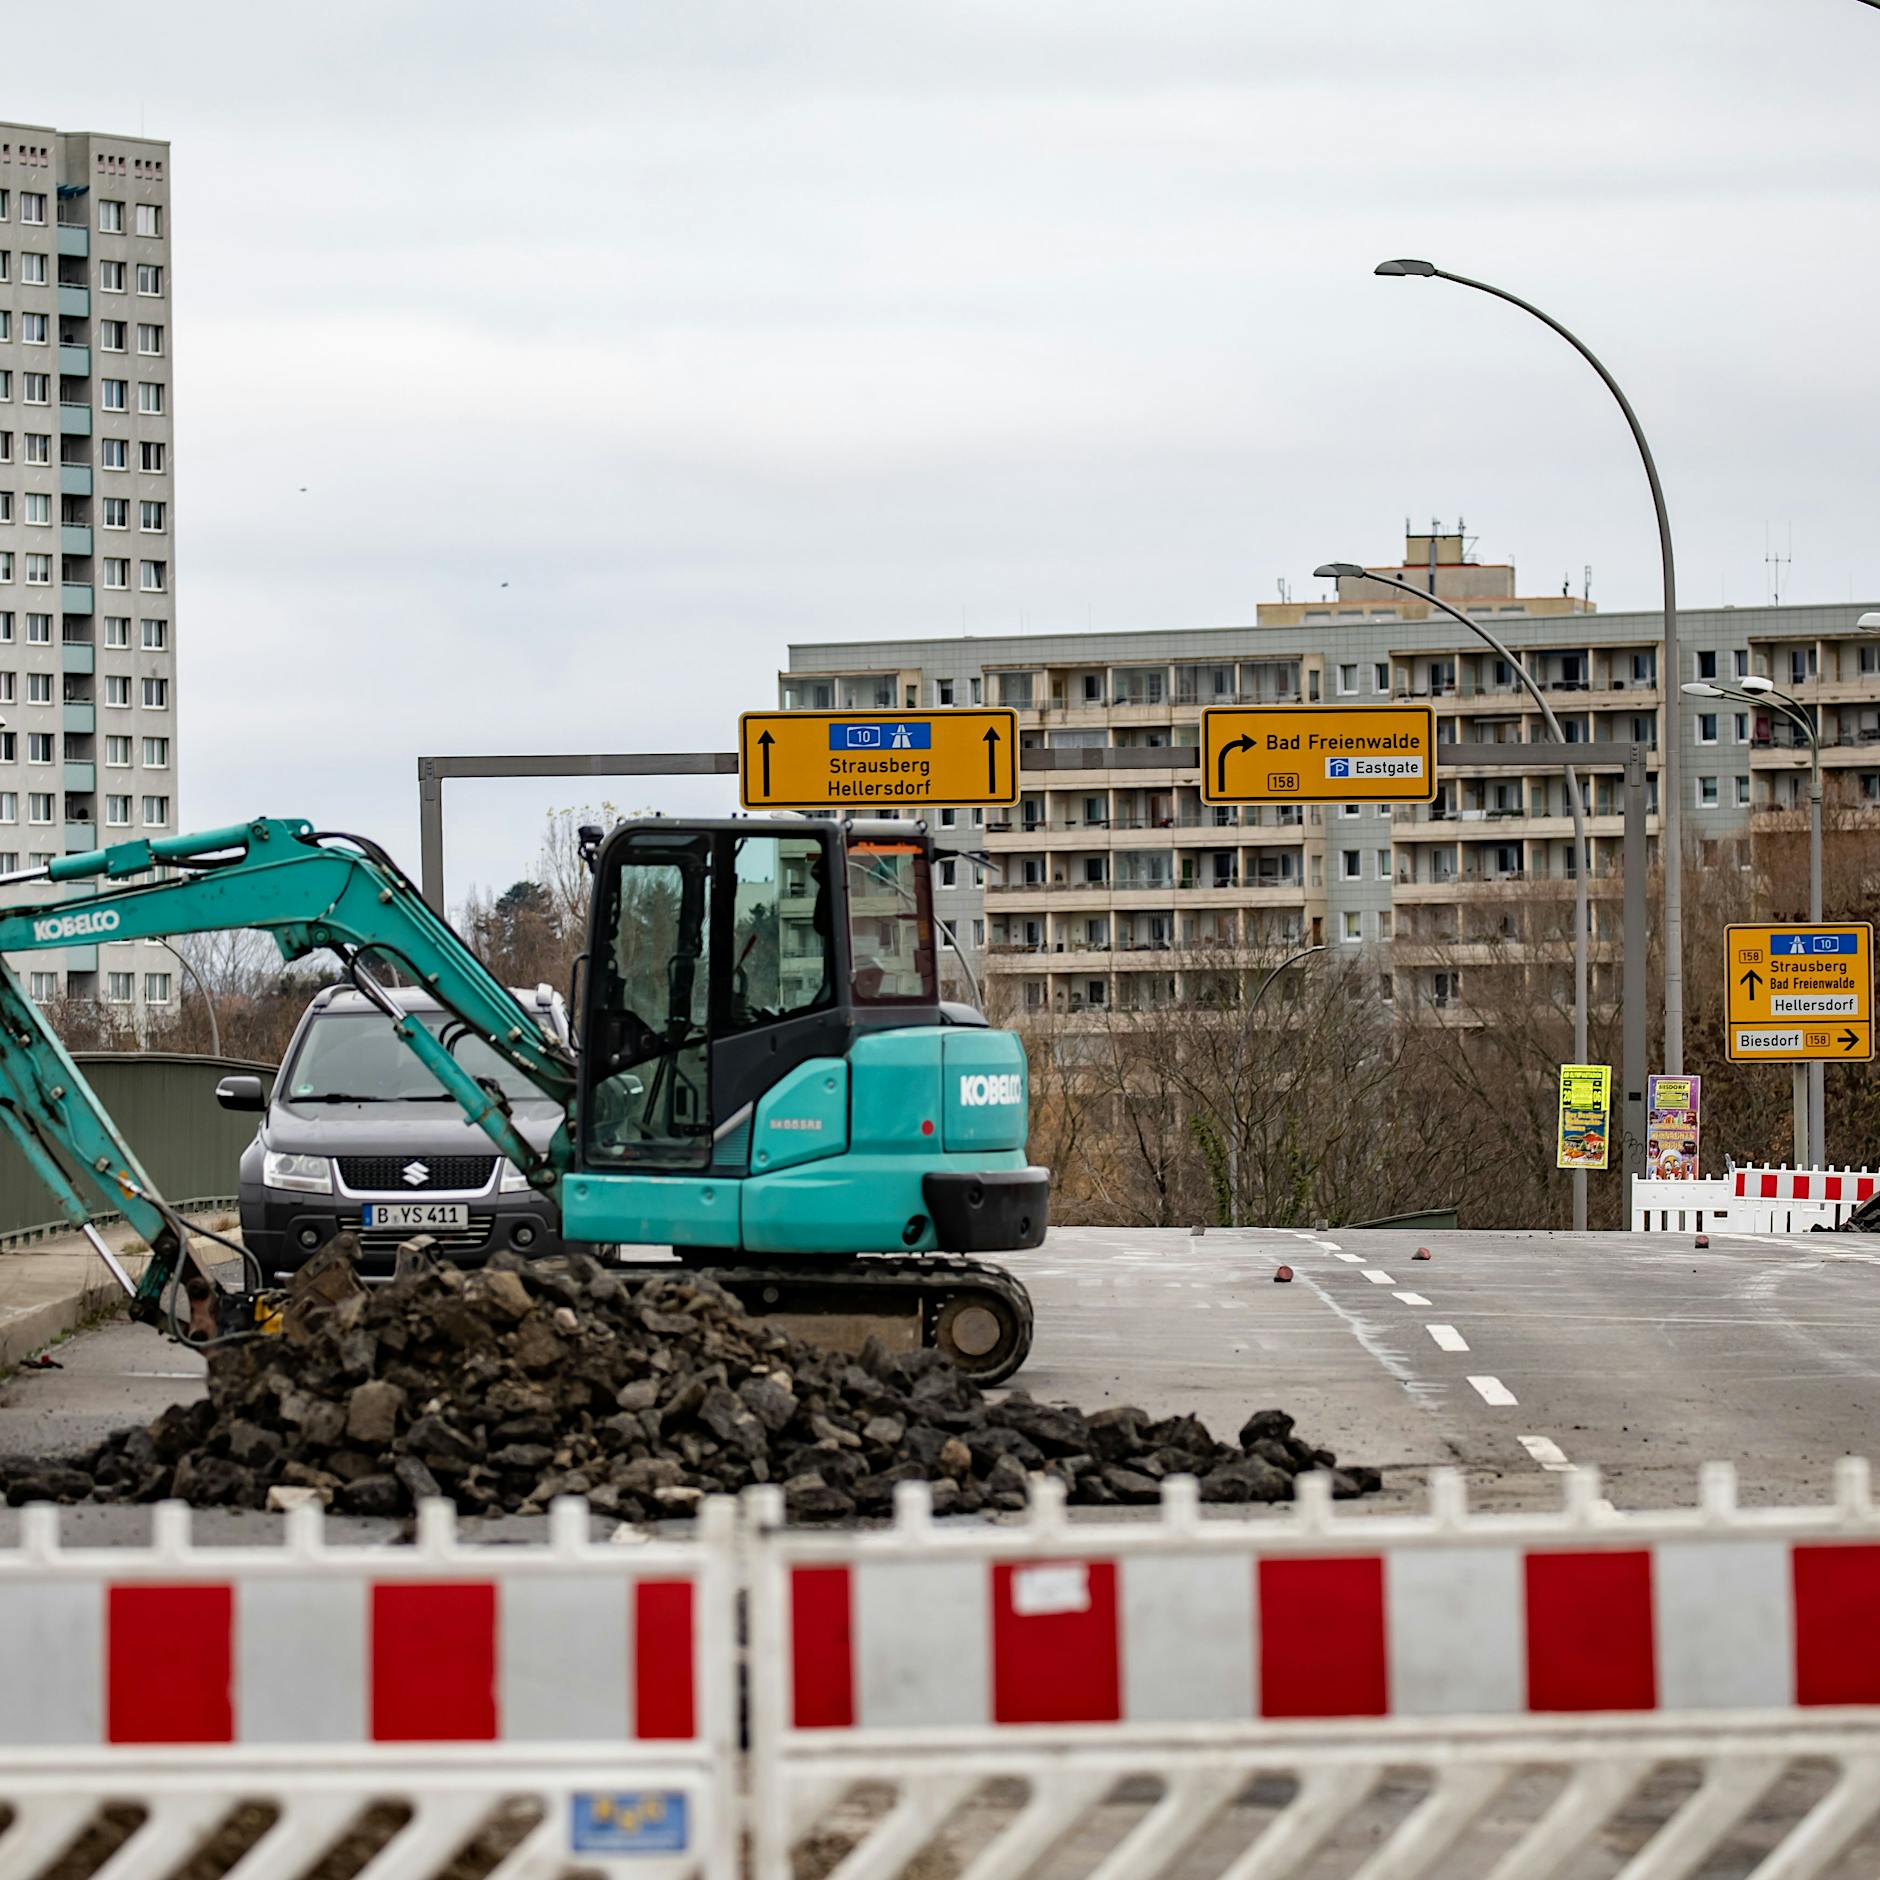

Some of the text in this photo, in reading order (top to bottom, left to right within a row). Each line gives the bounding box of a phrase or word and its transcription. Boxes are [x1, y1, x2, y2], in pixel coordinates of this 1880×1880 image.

[856, 730, 871, 743] 10
[1266, 733, 1421, 750] Bad Freienwalde
[829, 758, 931, 776] Strausberg
[1356, 761, 1419, 777] Eastgate
[828, 780, 932, 797] Hellersdorf
[1272, 776, 1295, 789] 158
[33, 909, 120, 942] KOBELCO
[1821, 939, 1832, 949] 10
[1742, 952, 1759, 961] 158
[1770, 960, 1847, 975] Strausberg
[1770, 977, 1855, 990] Bad Freienwalde
[1775, 999, 1854, 1011] Hellersdorf
[1740, 1034, 1826, 1047] Biesdorf 158
[377, 1207, 389, 1223] B
